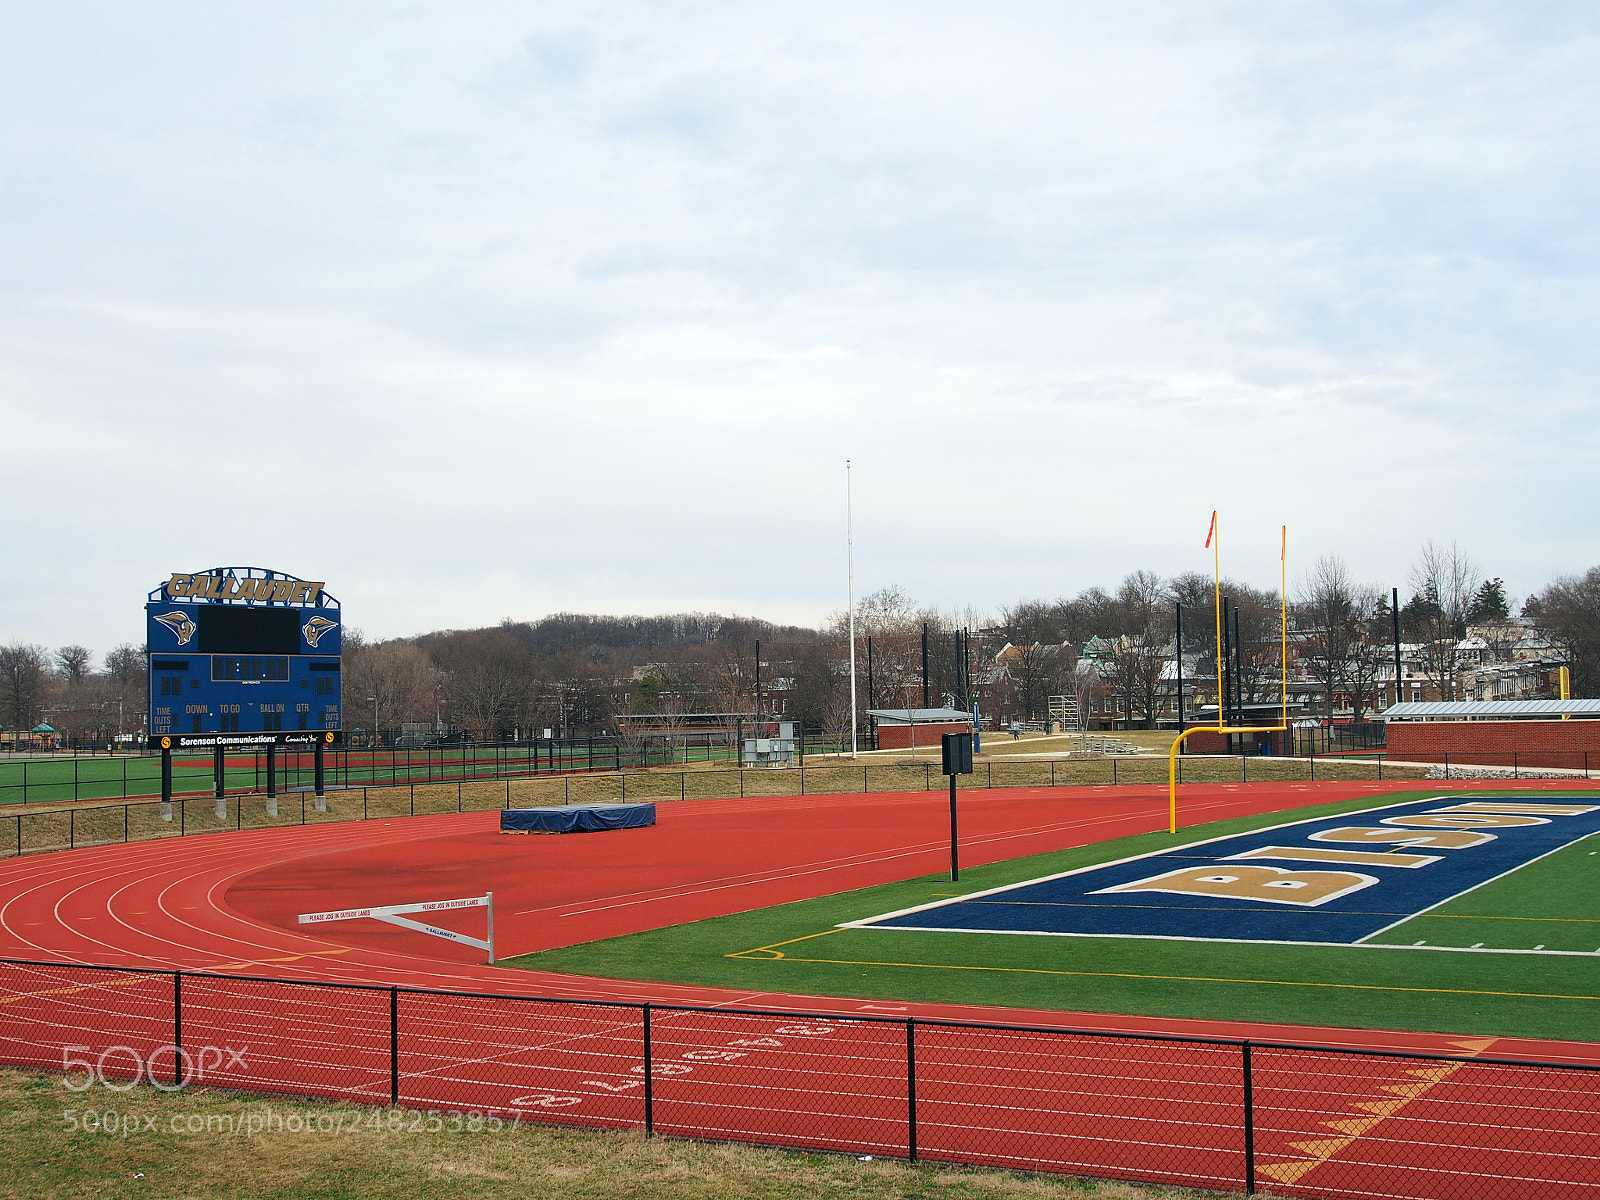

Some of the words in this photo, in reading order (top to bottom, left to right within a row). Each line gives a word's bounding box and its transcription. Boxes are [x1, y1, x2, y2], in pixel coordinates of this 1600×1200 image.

[166, 572, 326, 603] GALLAUDET
[156, 707, 171, 716] TIME
[185, 704, 208, 714] DOWN
[219, 704, 229, 714] TO
[230, 704, 241, 714] GO
[260, 703, 275, 713] BALL
[275, 703, 285, 713] ON
[296, 703, 310, 713] QTR
[325, 705, 338, 713] TIME
[154, 716, 171, 725] OUTS
[325, 713, 340, 721] OUTS
[155, 725, 171, 734] LEFT
[325, 721, 338, 729] LEFT
[180, 737, 216, 746] Sorenson
[216, 735, 276, 745] Communications
[1083, 801, 1600, 907] BISON
[450, 900, 466, 908] OUTSIDE
